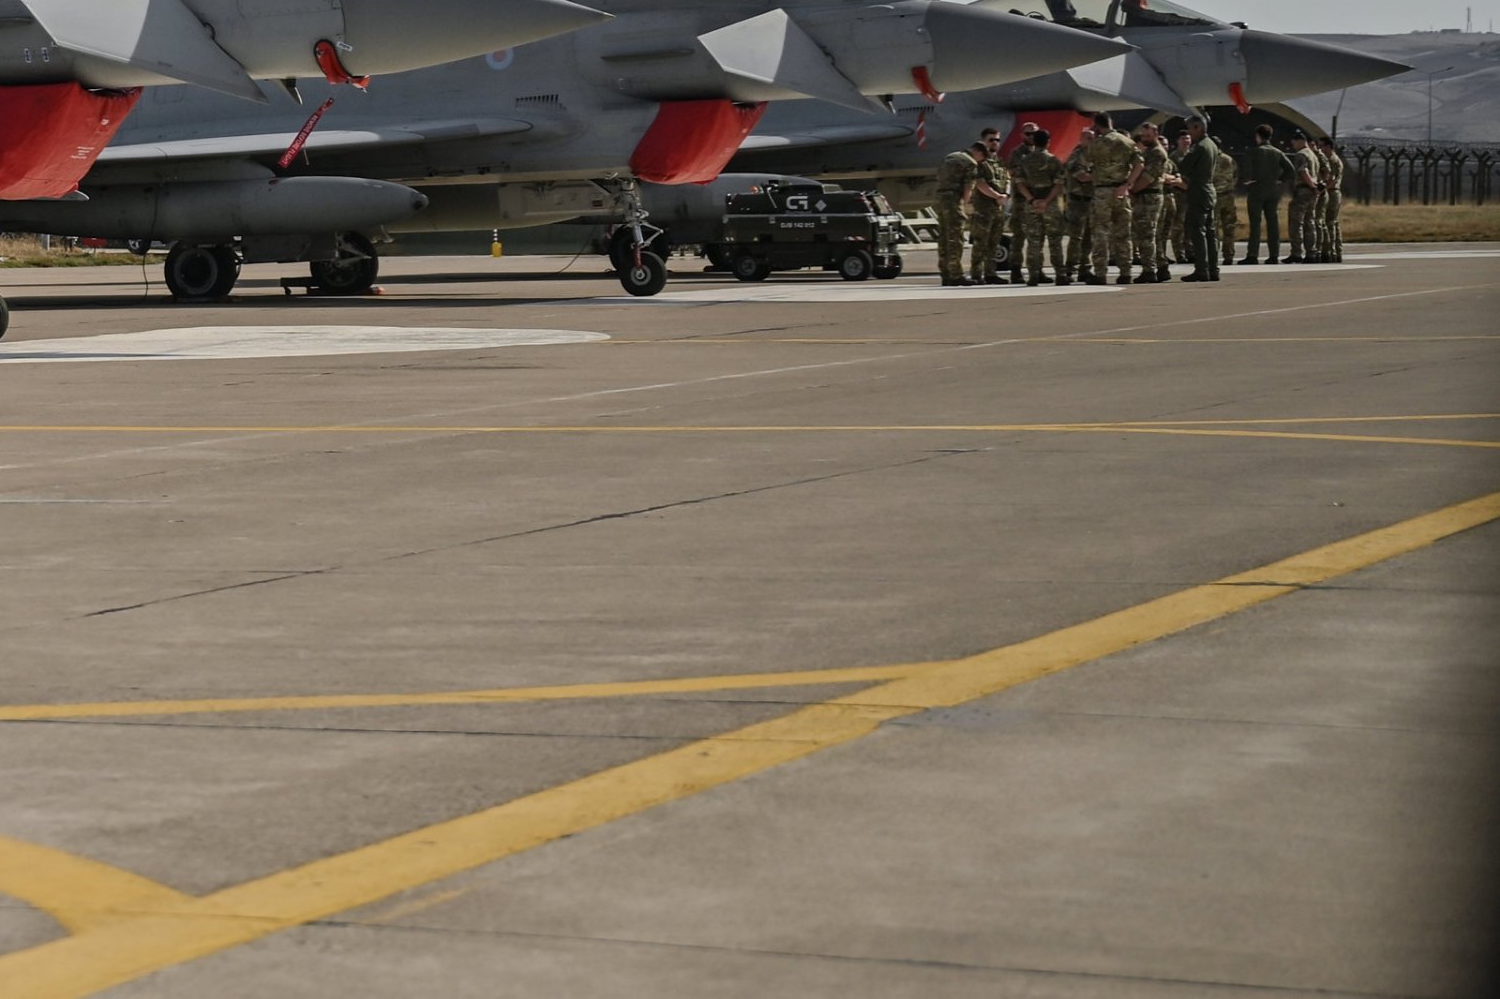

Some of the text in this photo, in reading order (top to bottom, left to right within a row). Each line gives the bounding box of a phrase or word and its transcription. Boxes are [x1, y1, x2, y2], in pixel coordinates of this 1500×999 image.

[281, 113, 318, 165] REMOVE BEFORE FLIGHT
